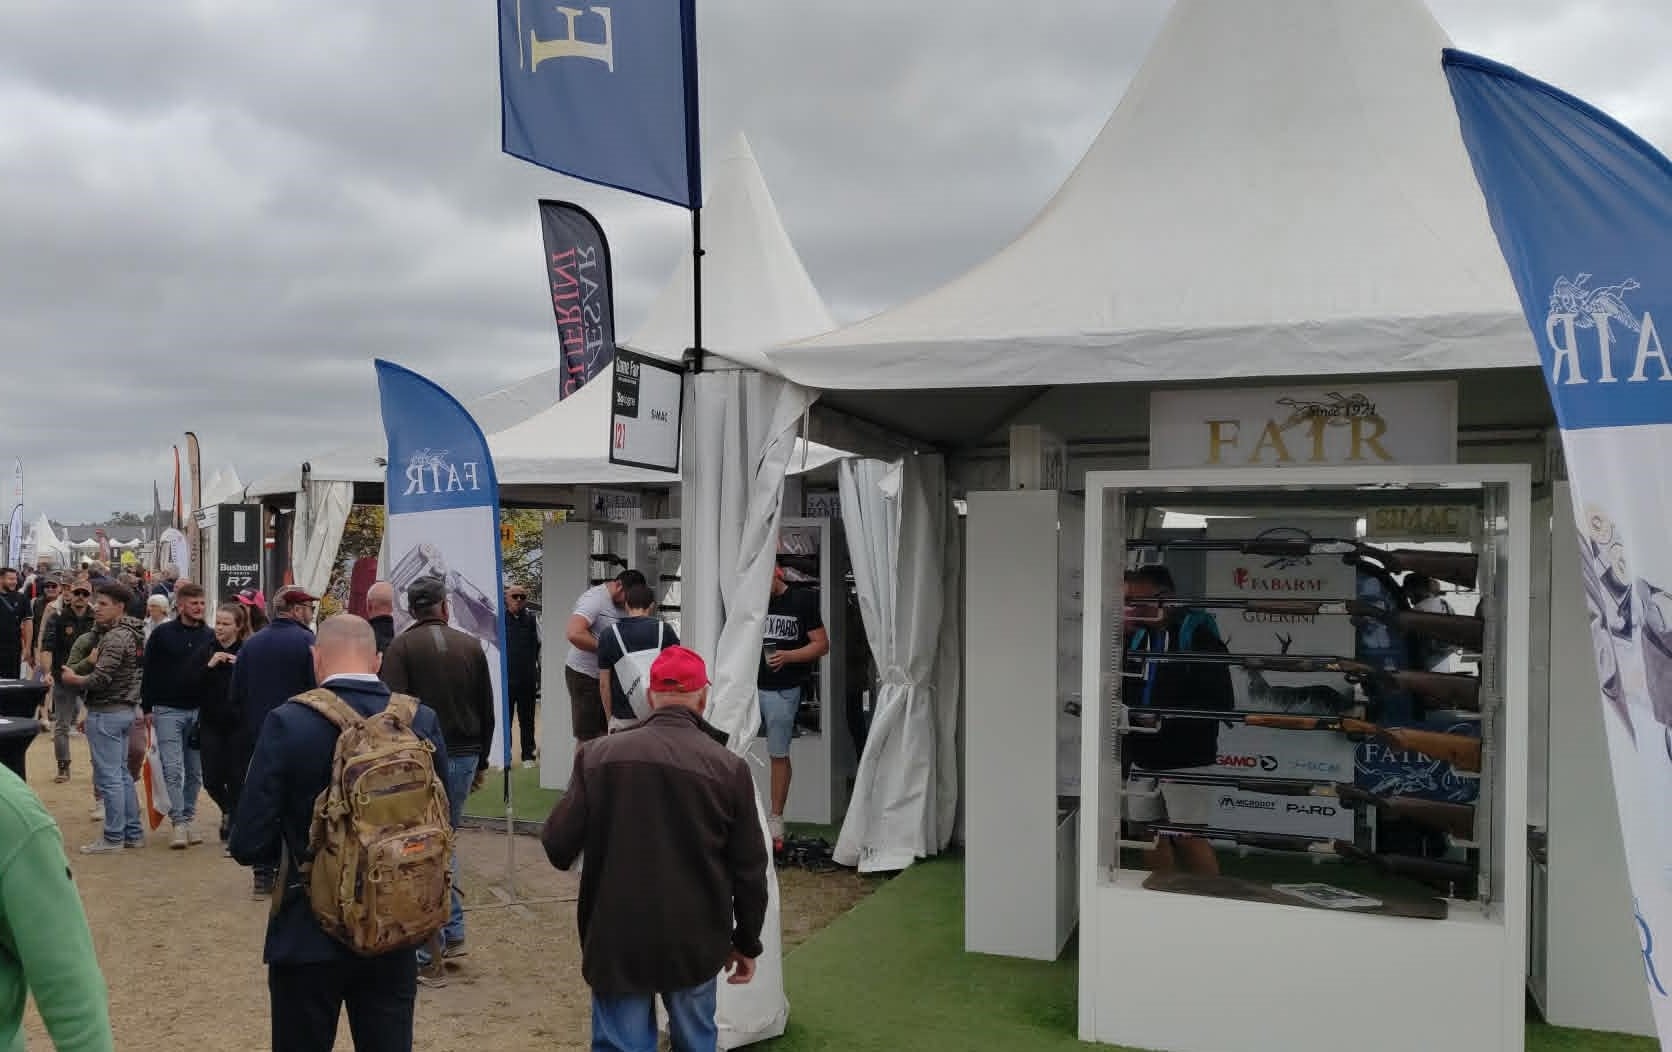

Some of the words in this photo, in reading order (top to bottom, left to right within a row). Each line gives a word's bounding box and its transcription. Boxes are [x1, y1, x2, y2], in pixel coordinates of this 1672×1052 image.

[1204, 414, 1397, 464] FAIR
[220, 563, 258, 571] Bushnell
[226, 576, 252, 587] R7
[1251, 576, 1320, 591] FABARM
[1216, 755, 1257, 767] GAMO
[1287, 803, 1336, 816] PARD
